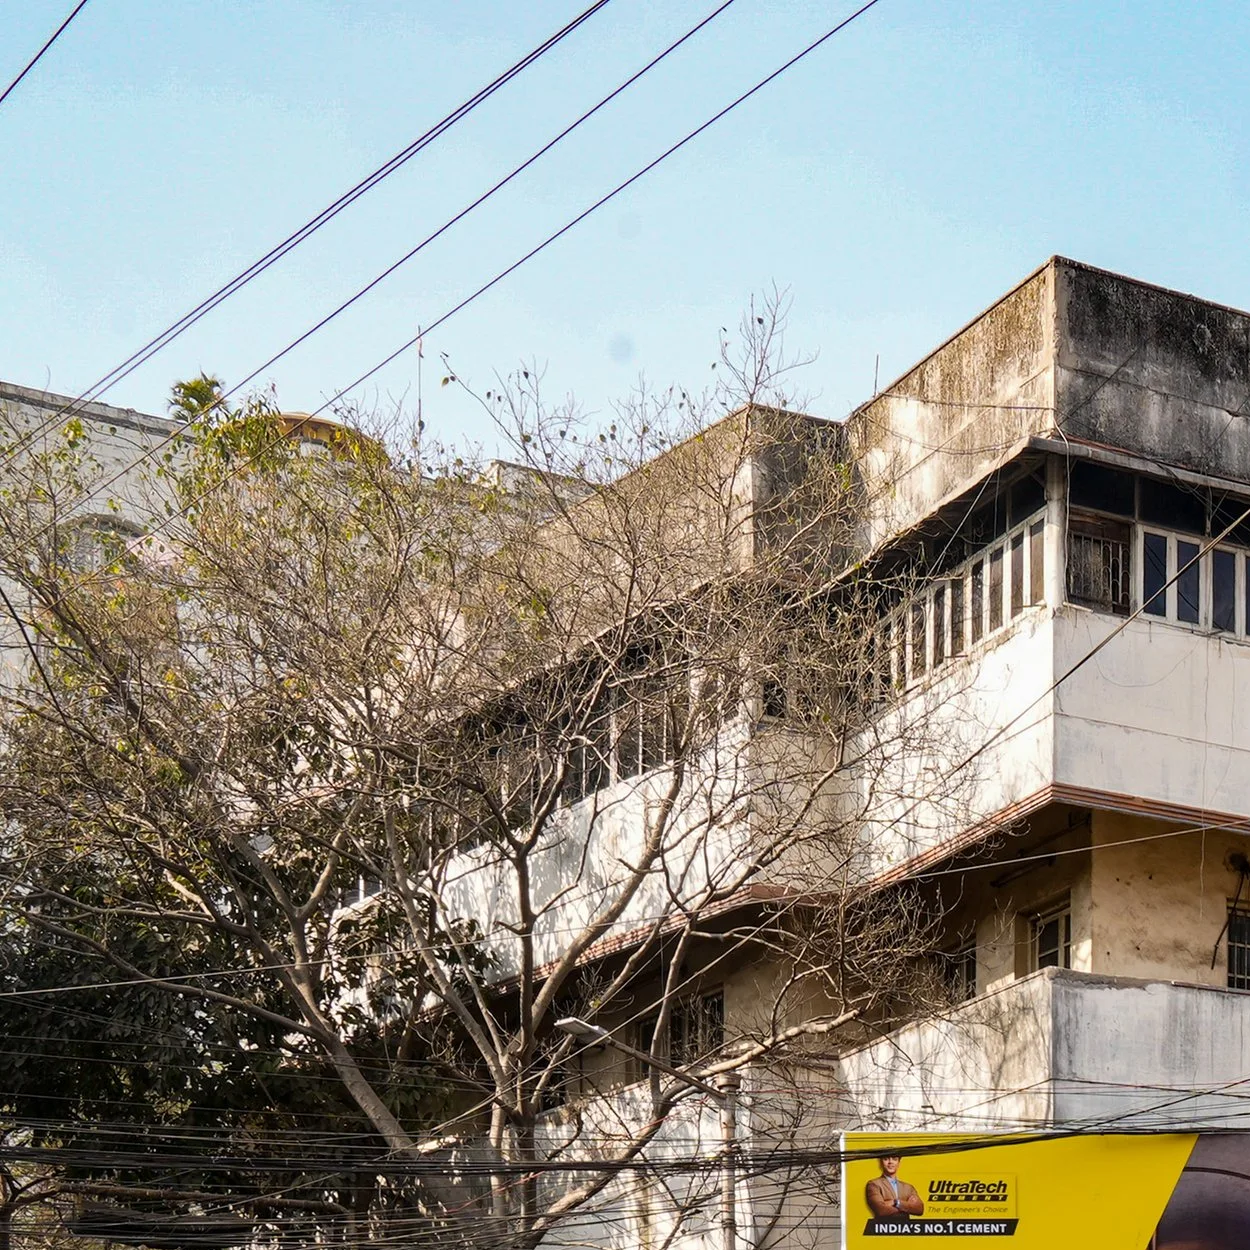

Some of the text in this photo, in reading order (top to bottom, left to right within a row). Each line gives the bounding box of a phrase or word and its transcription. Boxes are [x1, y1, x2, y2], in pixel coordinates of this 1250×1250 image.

[928, 1180, 1007, 1193] UltraTech
[943, 1206, 981, 1214] Engineer's
[875, 1221, 1007, 1234] INDIA'S NO.1 CEMENT
